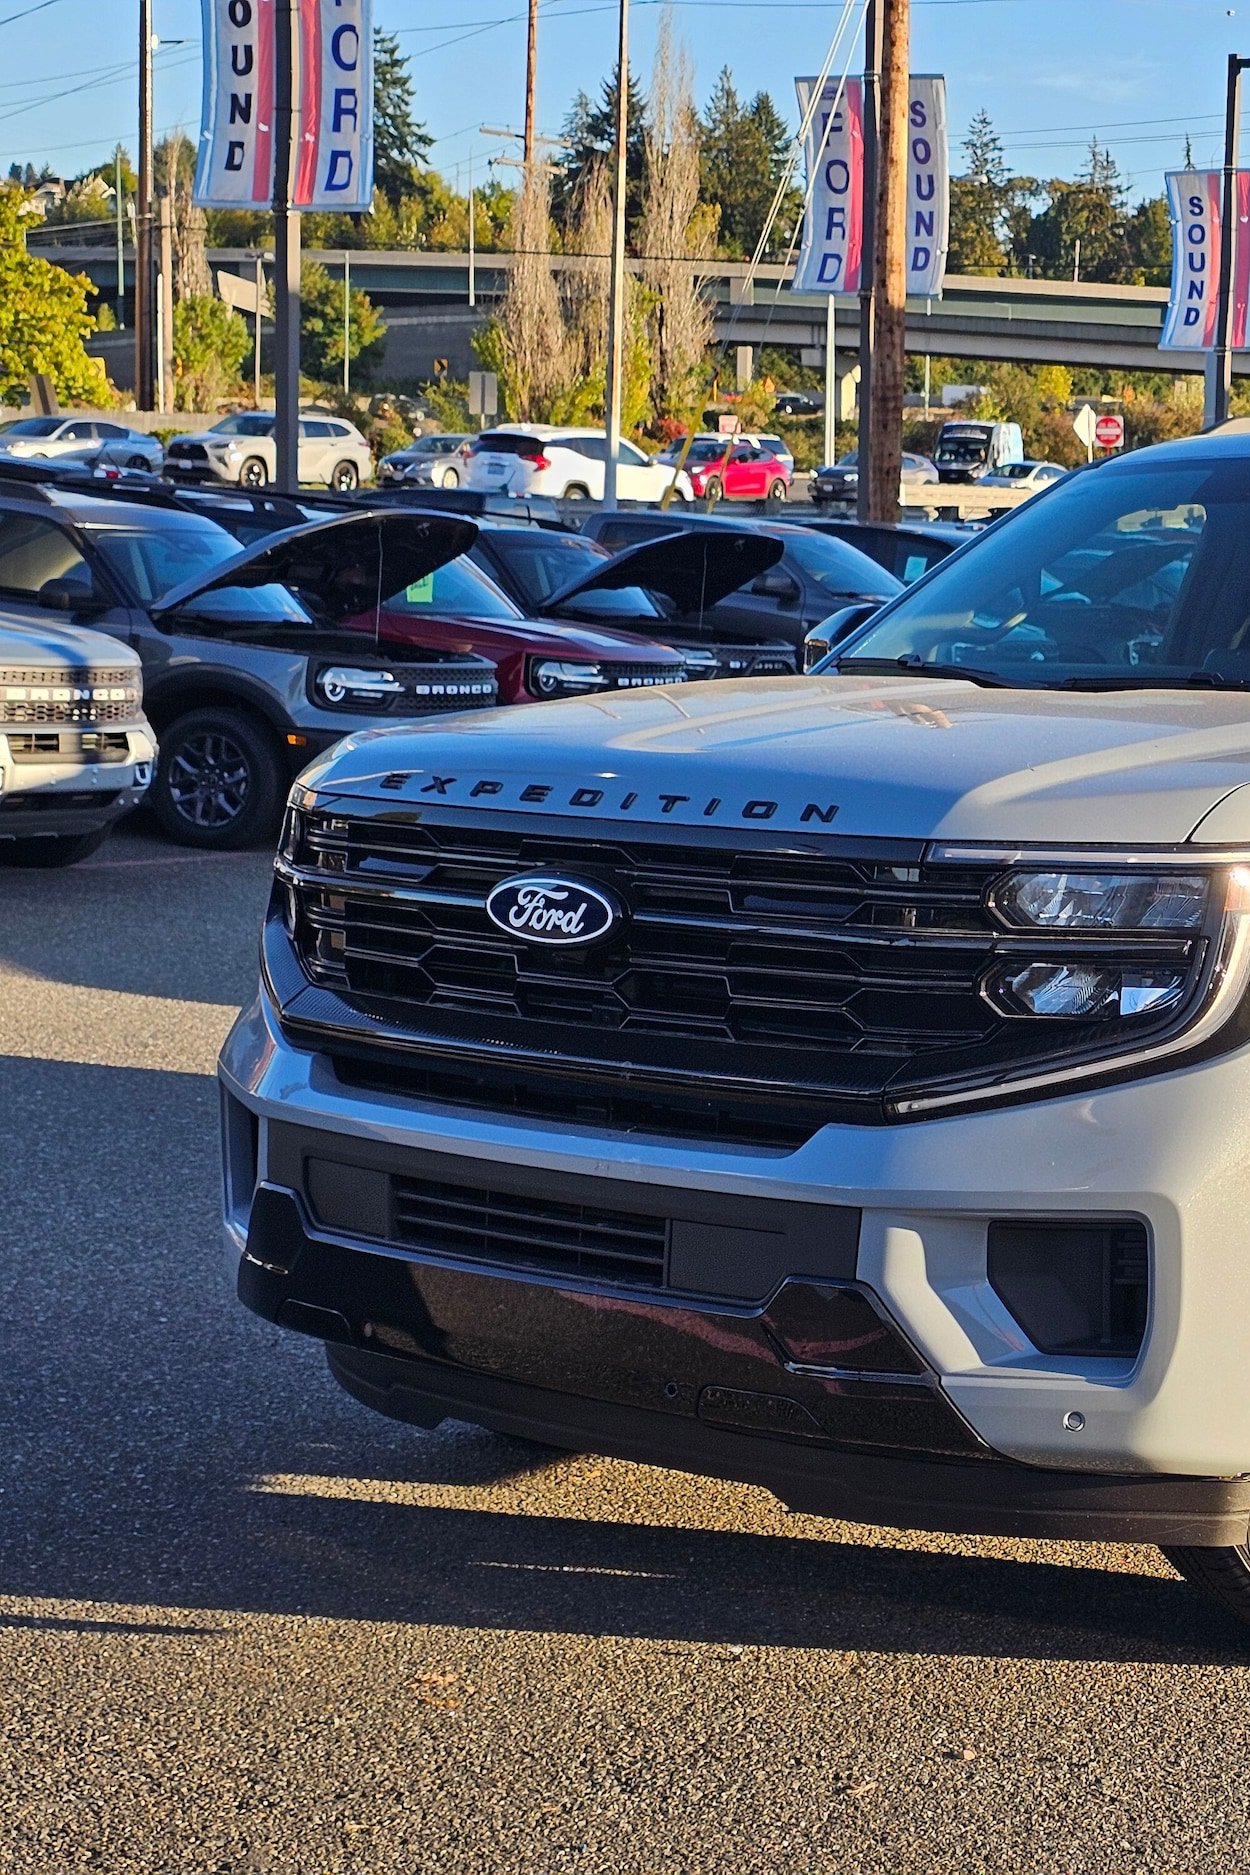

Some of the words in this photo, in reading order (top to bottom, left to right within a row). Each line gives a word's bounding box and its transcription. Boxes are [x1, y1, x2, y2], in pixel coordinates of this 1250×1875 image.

[224, 0, 253, 171] OUND
[324, 0, 358, 191] ORD
[816, 112, 850, 283] FORD
[910, 100, 935, 271] SOUND
[1184, 196, 1206, 326] SOUND
[415, 684, 492, 695] BRONCO
[380, 772, 840, 823] EXPEDITION
[509, 886, 588, 934] Ford
